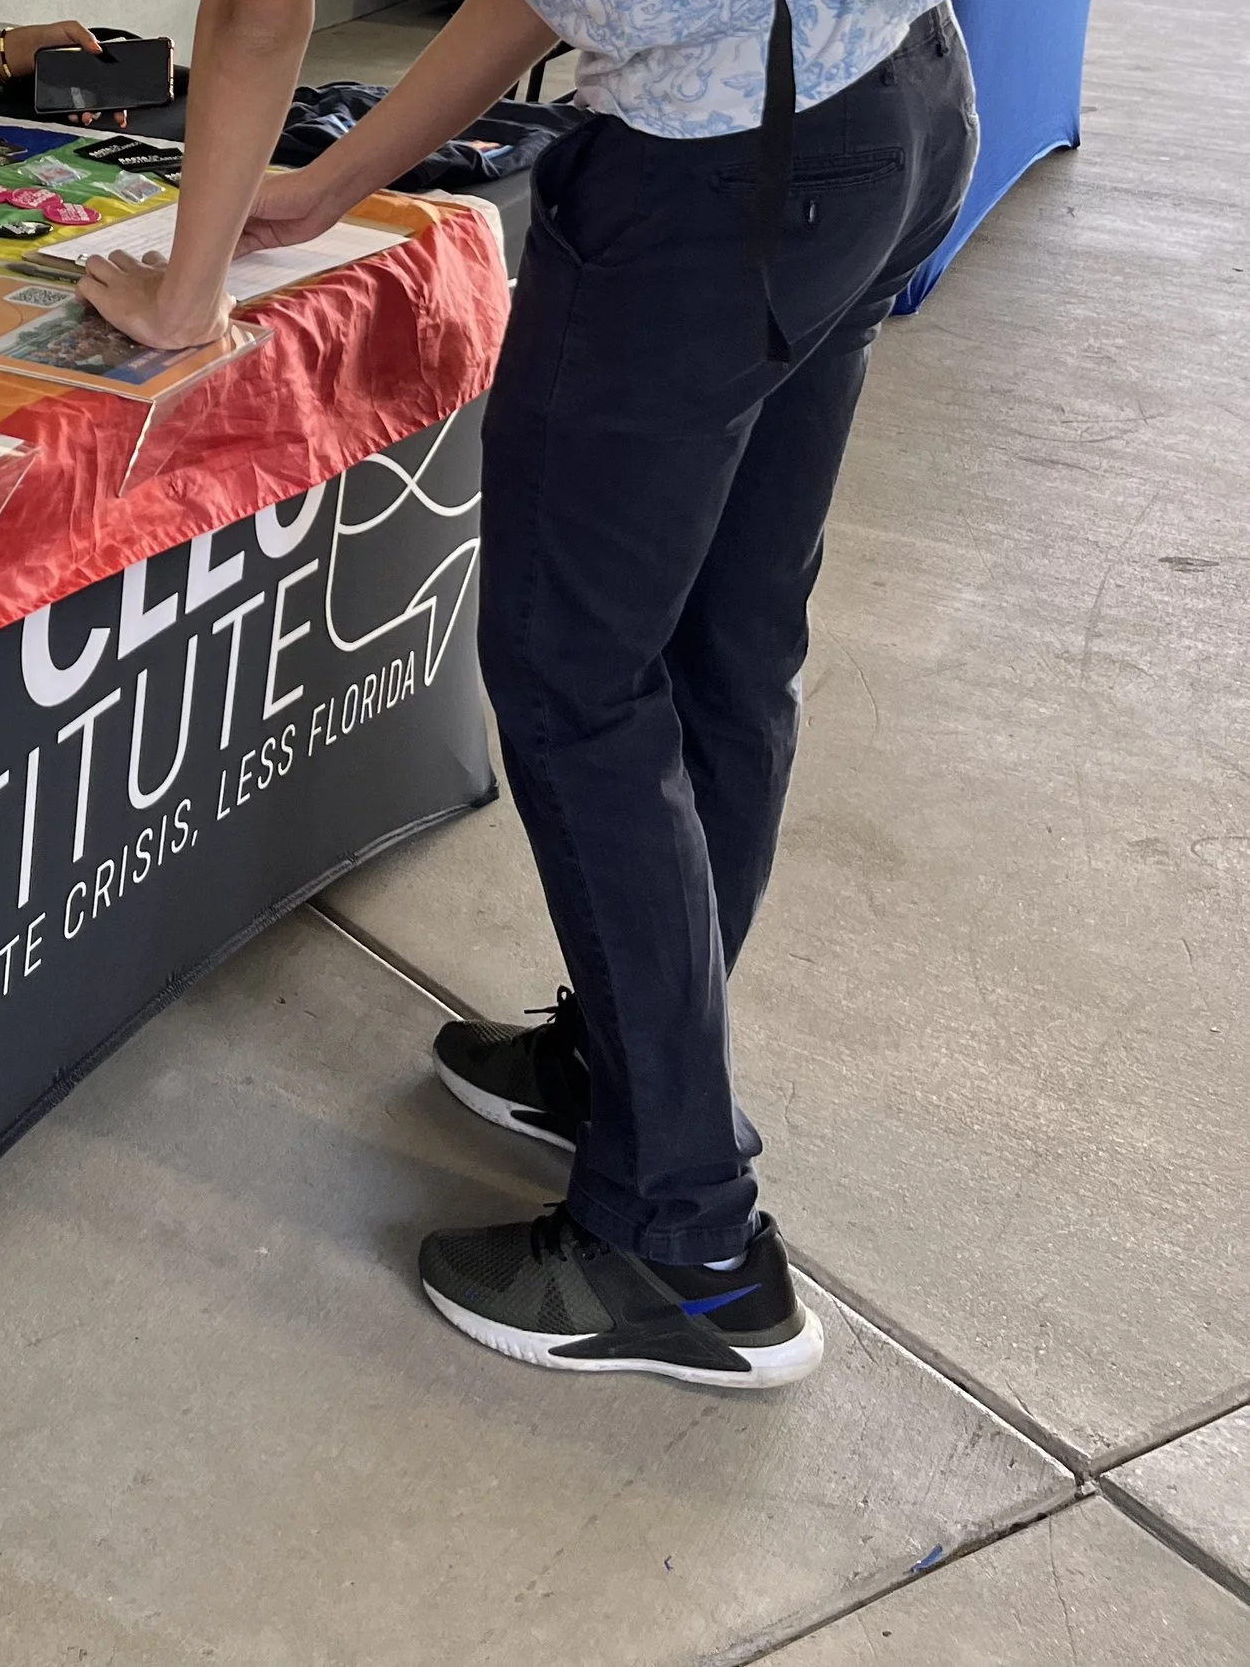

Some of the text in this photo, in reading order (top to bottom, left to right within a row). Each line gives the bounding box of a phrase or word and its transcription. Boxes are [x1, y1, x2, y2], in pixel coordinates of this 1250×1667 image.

[63, 798, 199, 940] CRISIS,
[216, 724, 296, 822] LESS
[307, 650, 416, 758] FLORIDA
